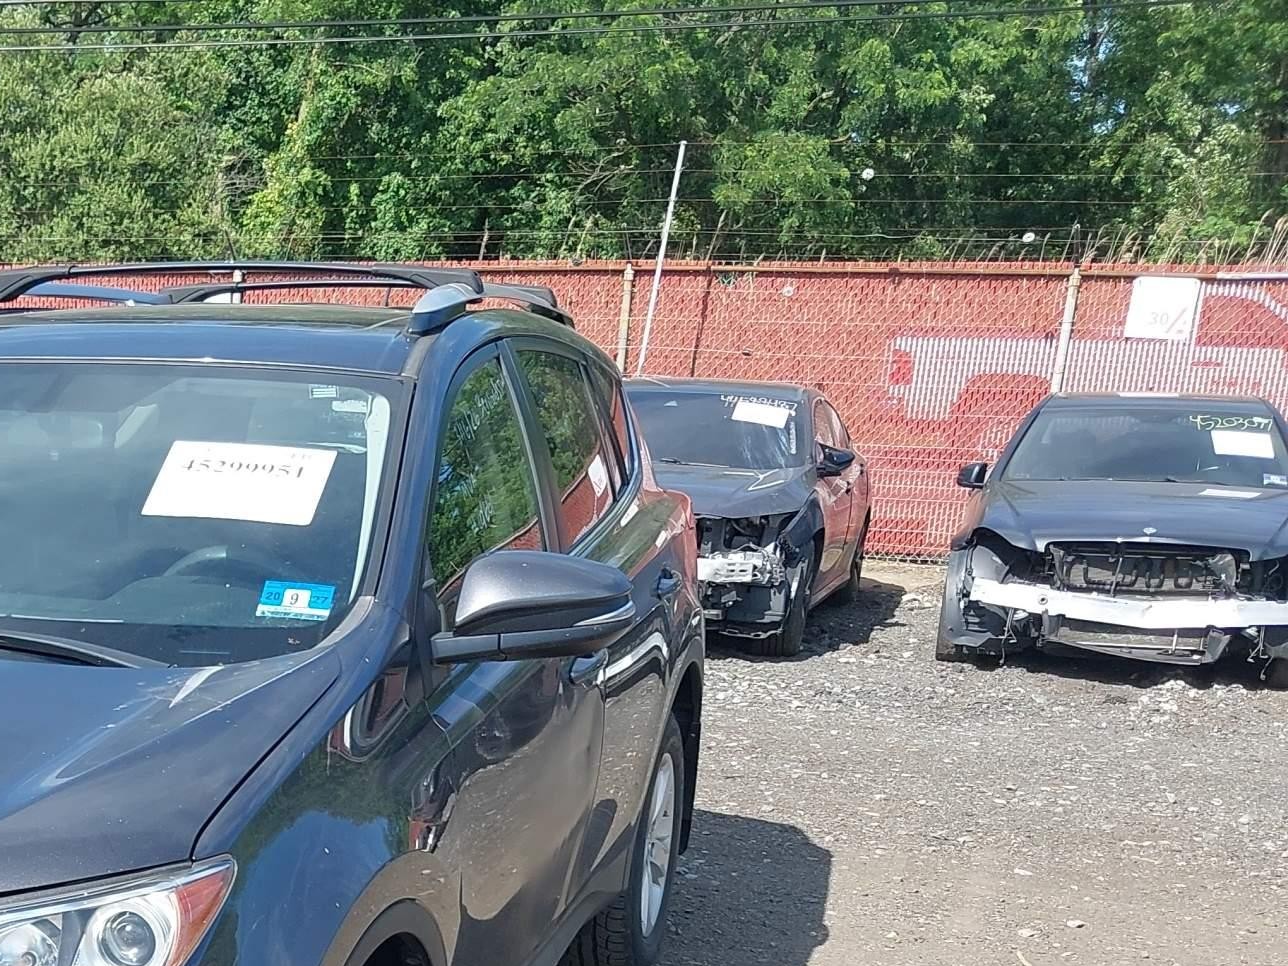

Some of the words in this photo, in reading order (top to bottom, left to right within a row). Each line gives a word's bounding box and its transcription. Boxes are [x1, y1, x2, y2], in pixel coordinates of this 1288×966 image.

[264, 591, 281, 601] 20
[289, 592, 300, 606] 9
[311, 595, 330, 605] 27
